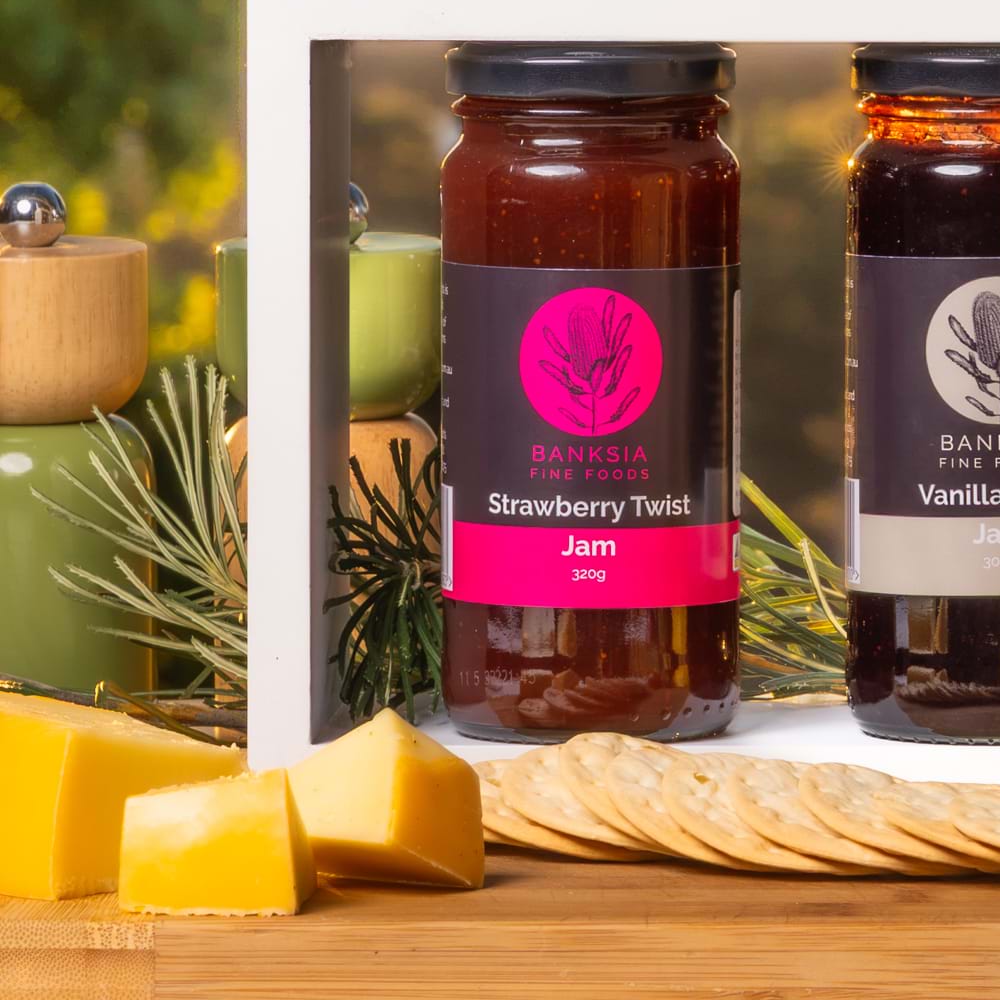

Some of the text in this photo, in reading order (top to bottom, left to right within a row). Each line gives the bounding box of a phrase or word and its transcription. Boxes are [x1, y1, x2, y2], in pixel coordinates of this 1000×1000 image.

[531, 444, 647, 462] BANKSIA
[939, 457, 982, 468] FINE
[529, 467, 649, 480] FINE FOODS
[488, 492, 691, 522] Strawberry Twist
[560, 534, 616, 556] Jam
[571, 568, 606, 582] 320g
